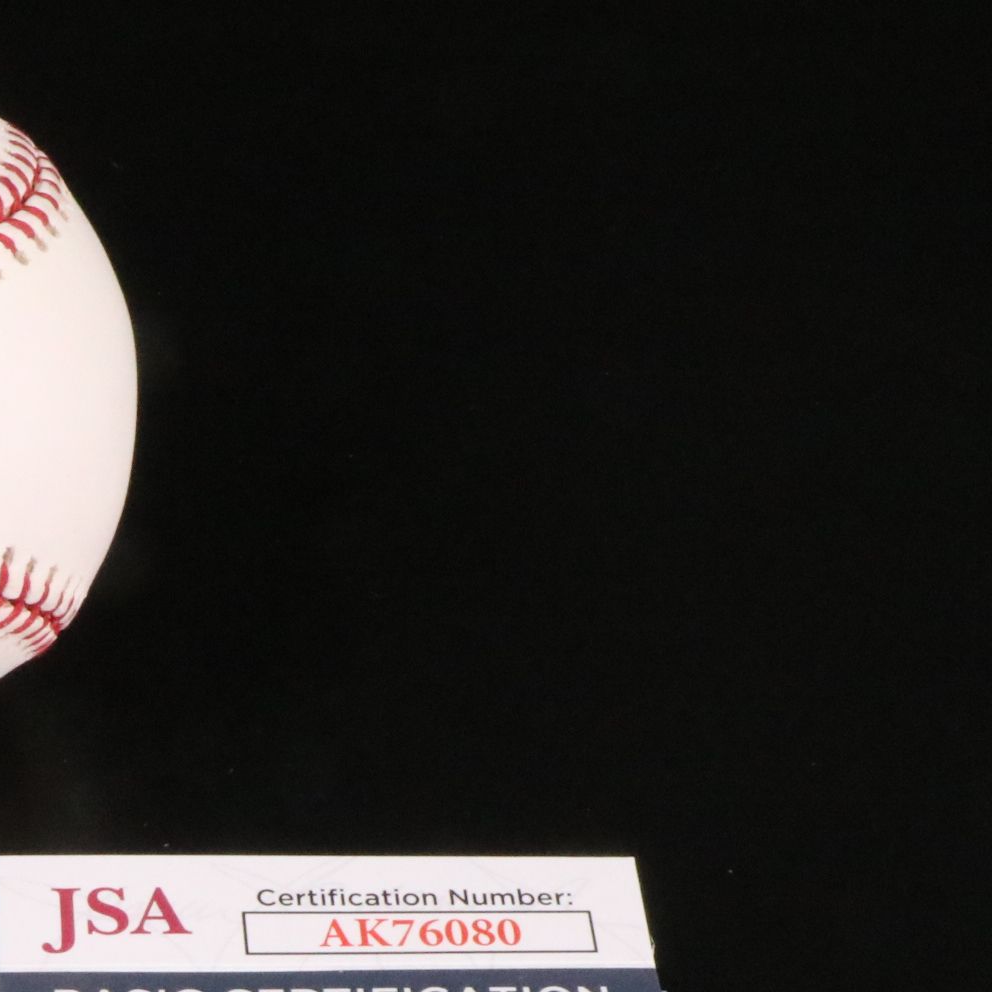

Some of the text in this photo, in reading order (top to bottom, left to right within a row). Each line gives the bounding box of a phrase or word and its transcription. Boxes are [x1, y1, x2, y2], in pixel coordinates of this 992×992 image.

[256, 888, 573, 907] Certification Number:
[41, 886, 193, 954] JSA
[319, 918, 522, 948] AK76080
